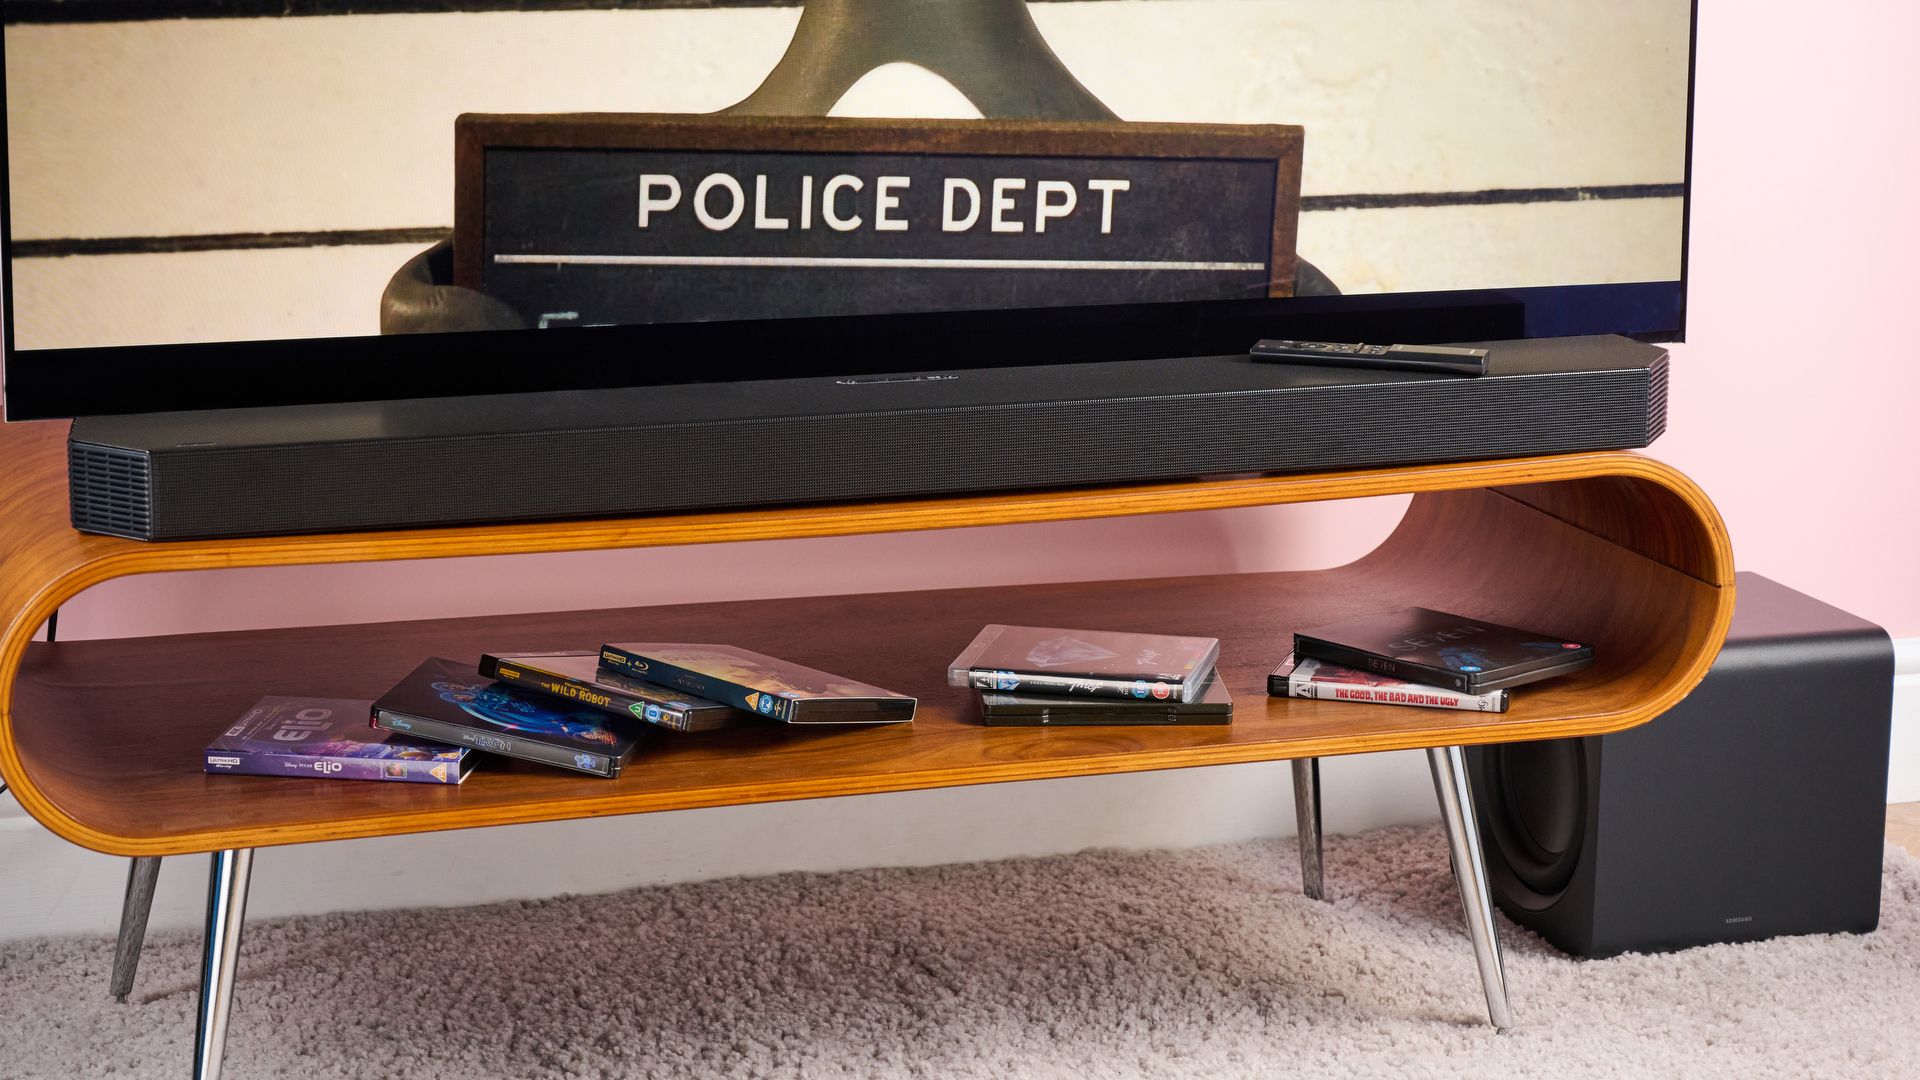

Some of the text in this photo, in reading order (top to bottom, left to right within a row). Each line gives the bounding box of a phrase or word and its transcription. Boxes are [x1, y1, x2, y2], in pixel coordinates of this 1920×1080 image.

[638, 172, 1131, 234] POLICE DEPT
[551, 683, 577, 697] WILD
[578, 690, 611, 707] ROBOT
[1335, 689, 1459, 707] THE GOOD, THE BAD AND THE UGLY
[1725, 916, 1753, 924] SAMSUNG
